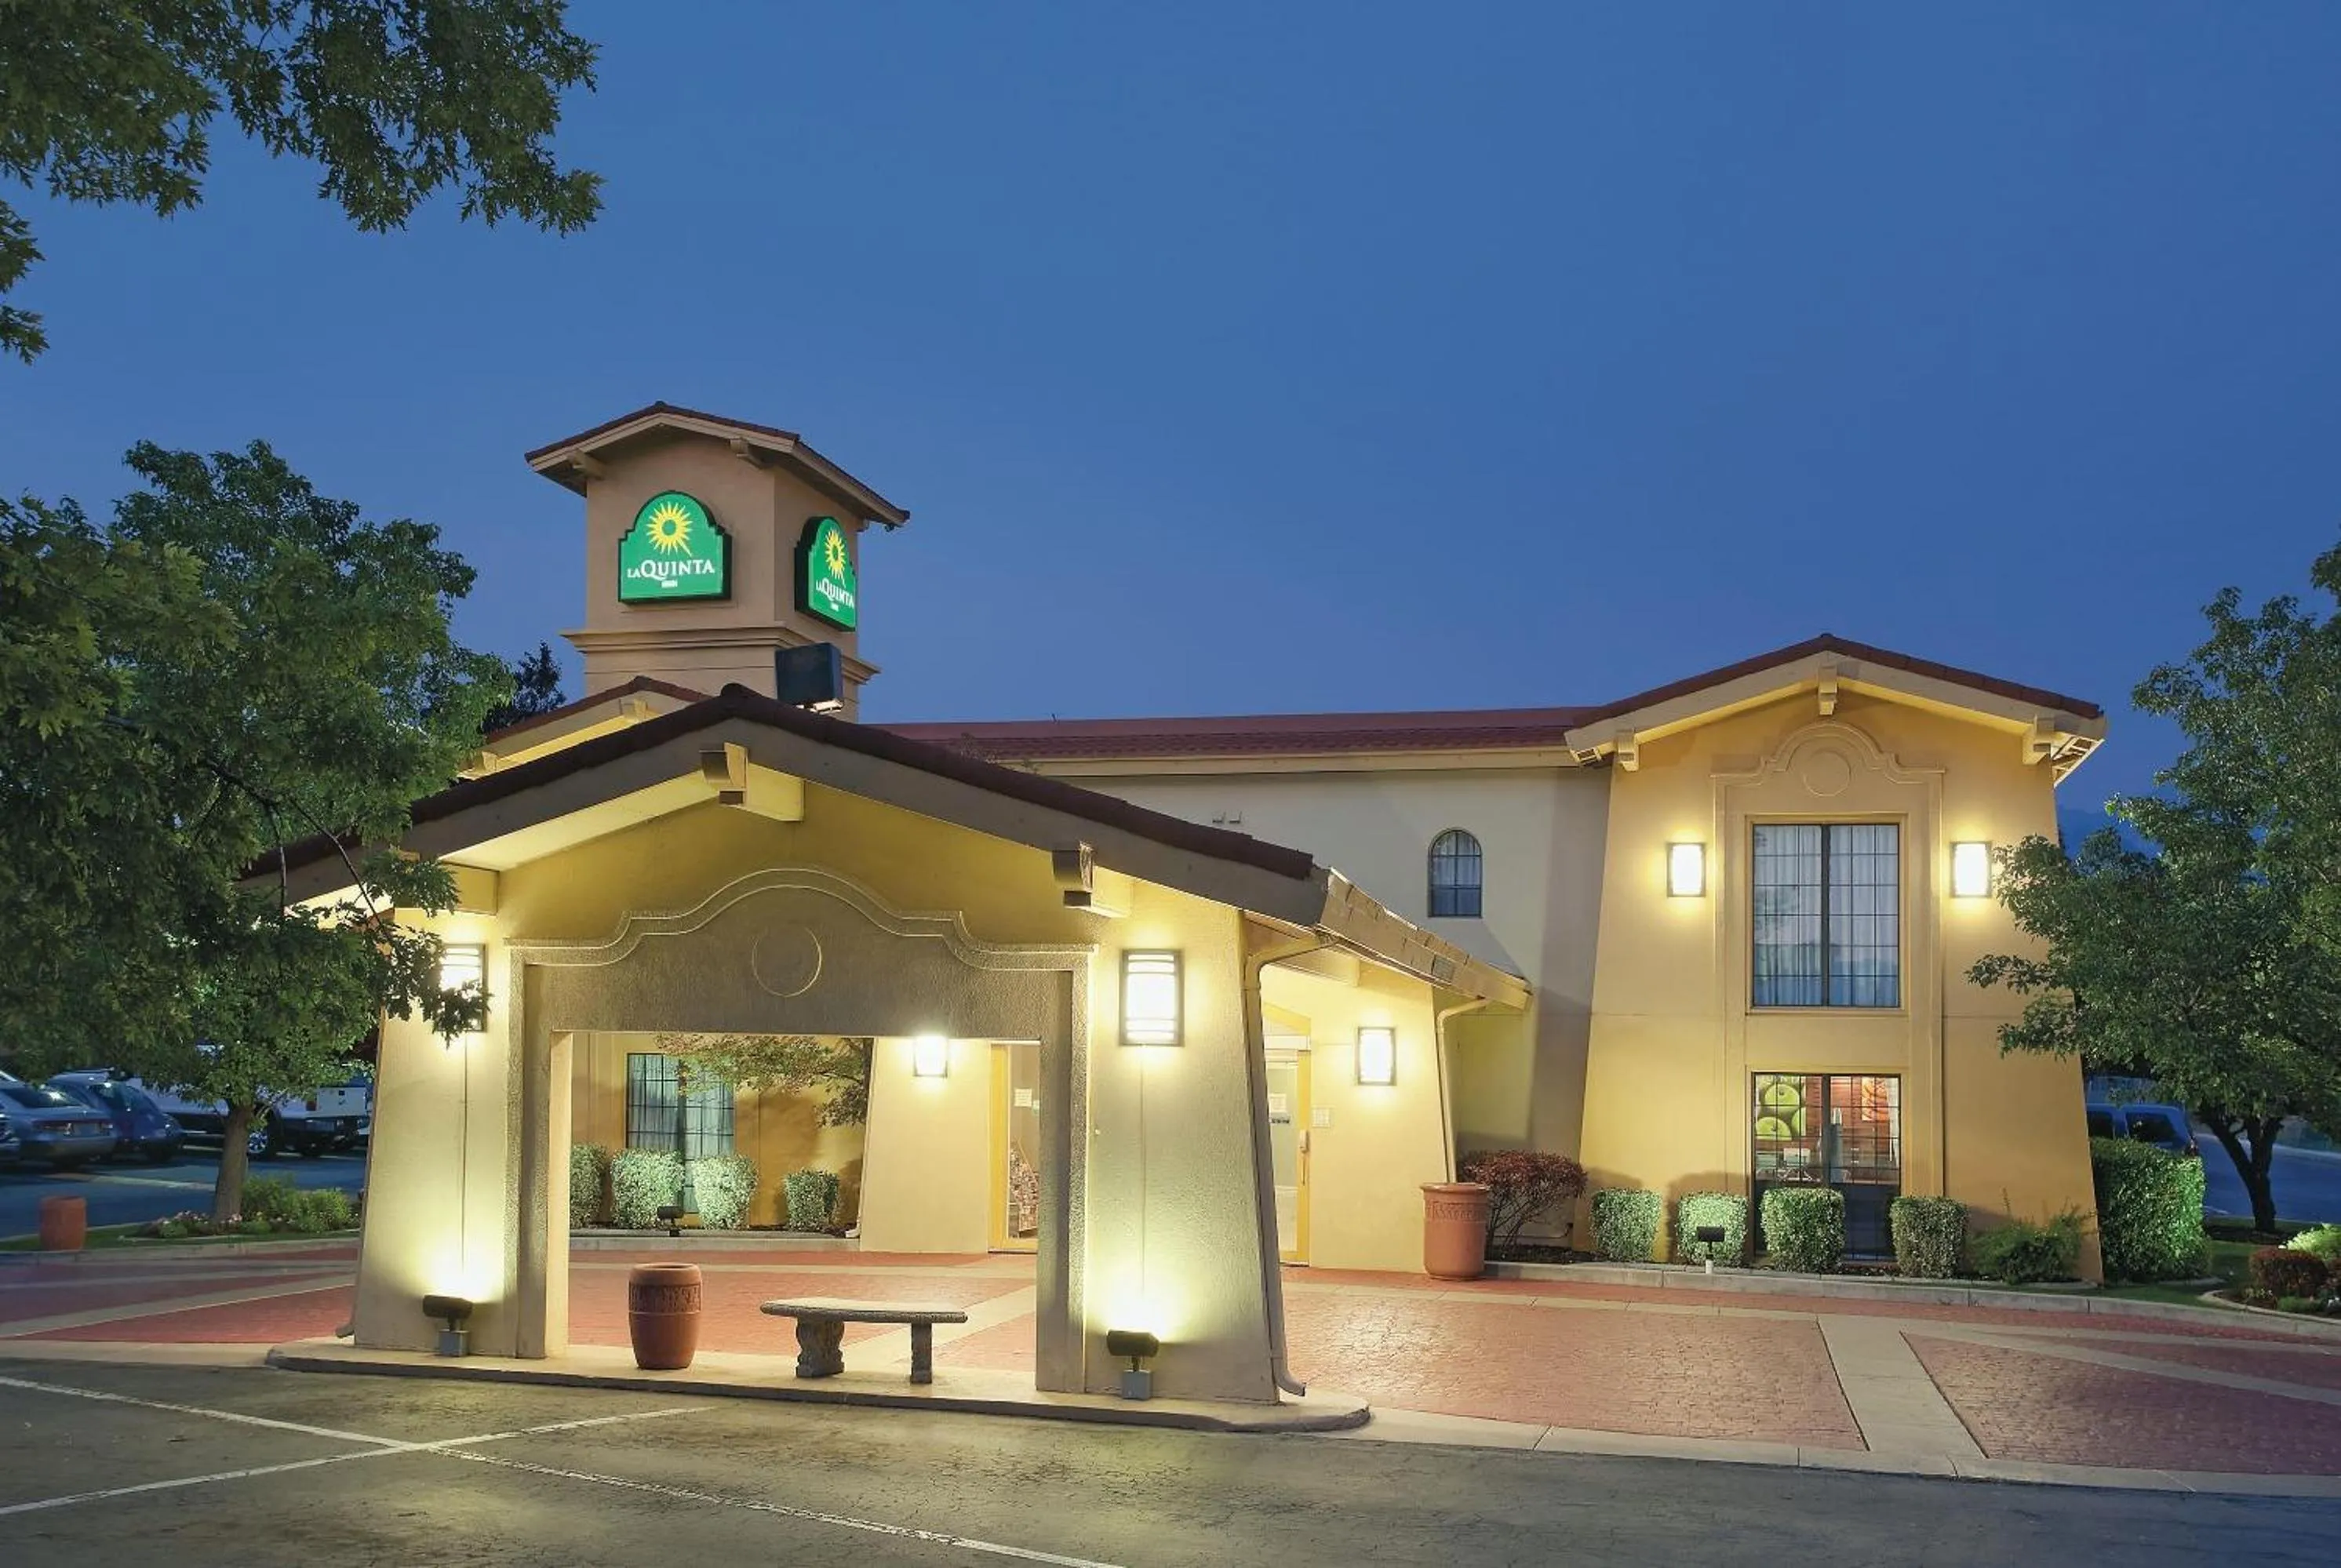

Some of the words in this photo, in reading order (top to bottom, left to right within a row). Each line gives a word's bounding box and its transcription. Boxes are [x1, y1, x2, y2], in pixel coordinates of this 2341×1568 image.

[627, 568, 641, 578] LA
[640, 559, 715, 581] QUINTA
[822, 577, 854, 609] QUINTA
